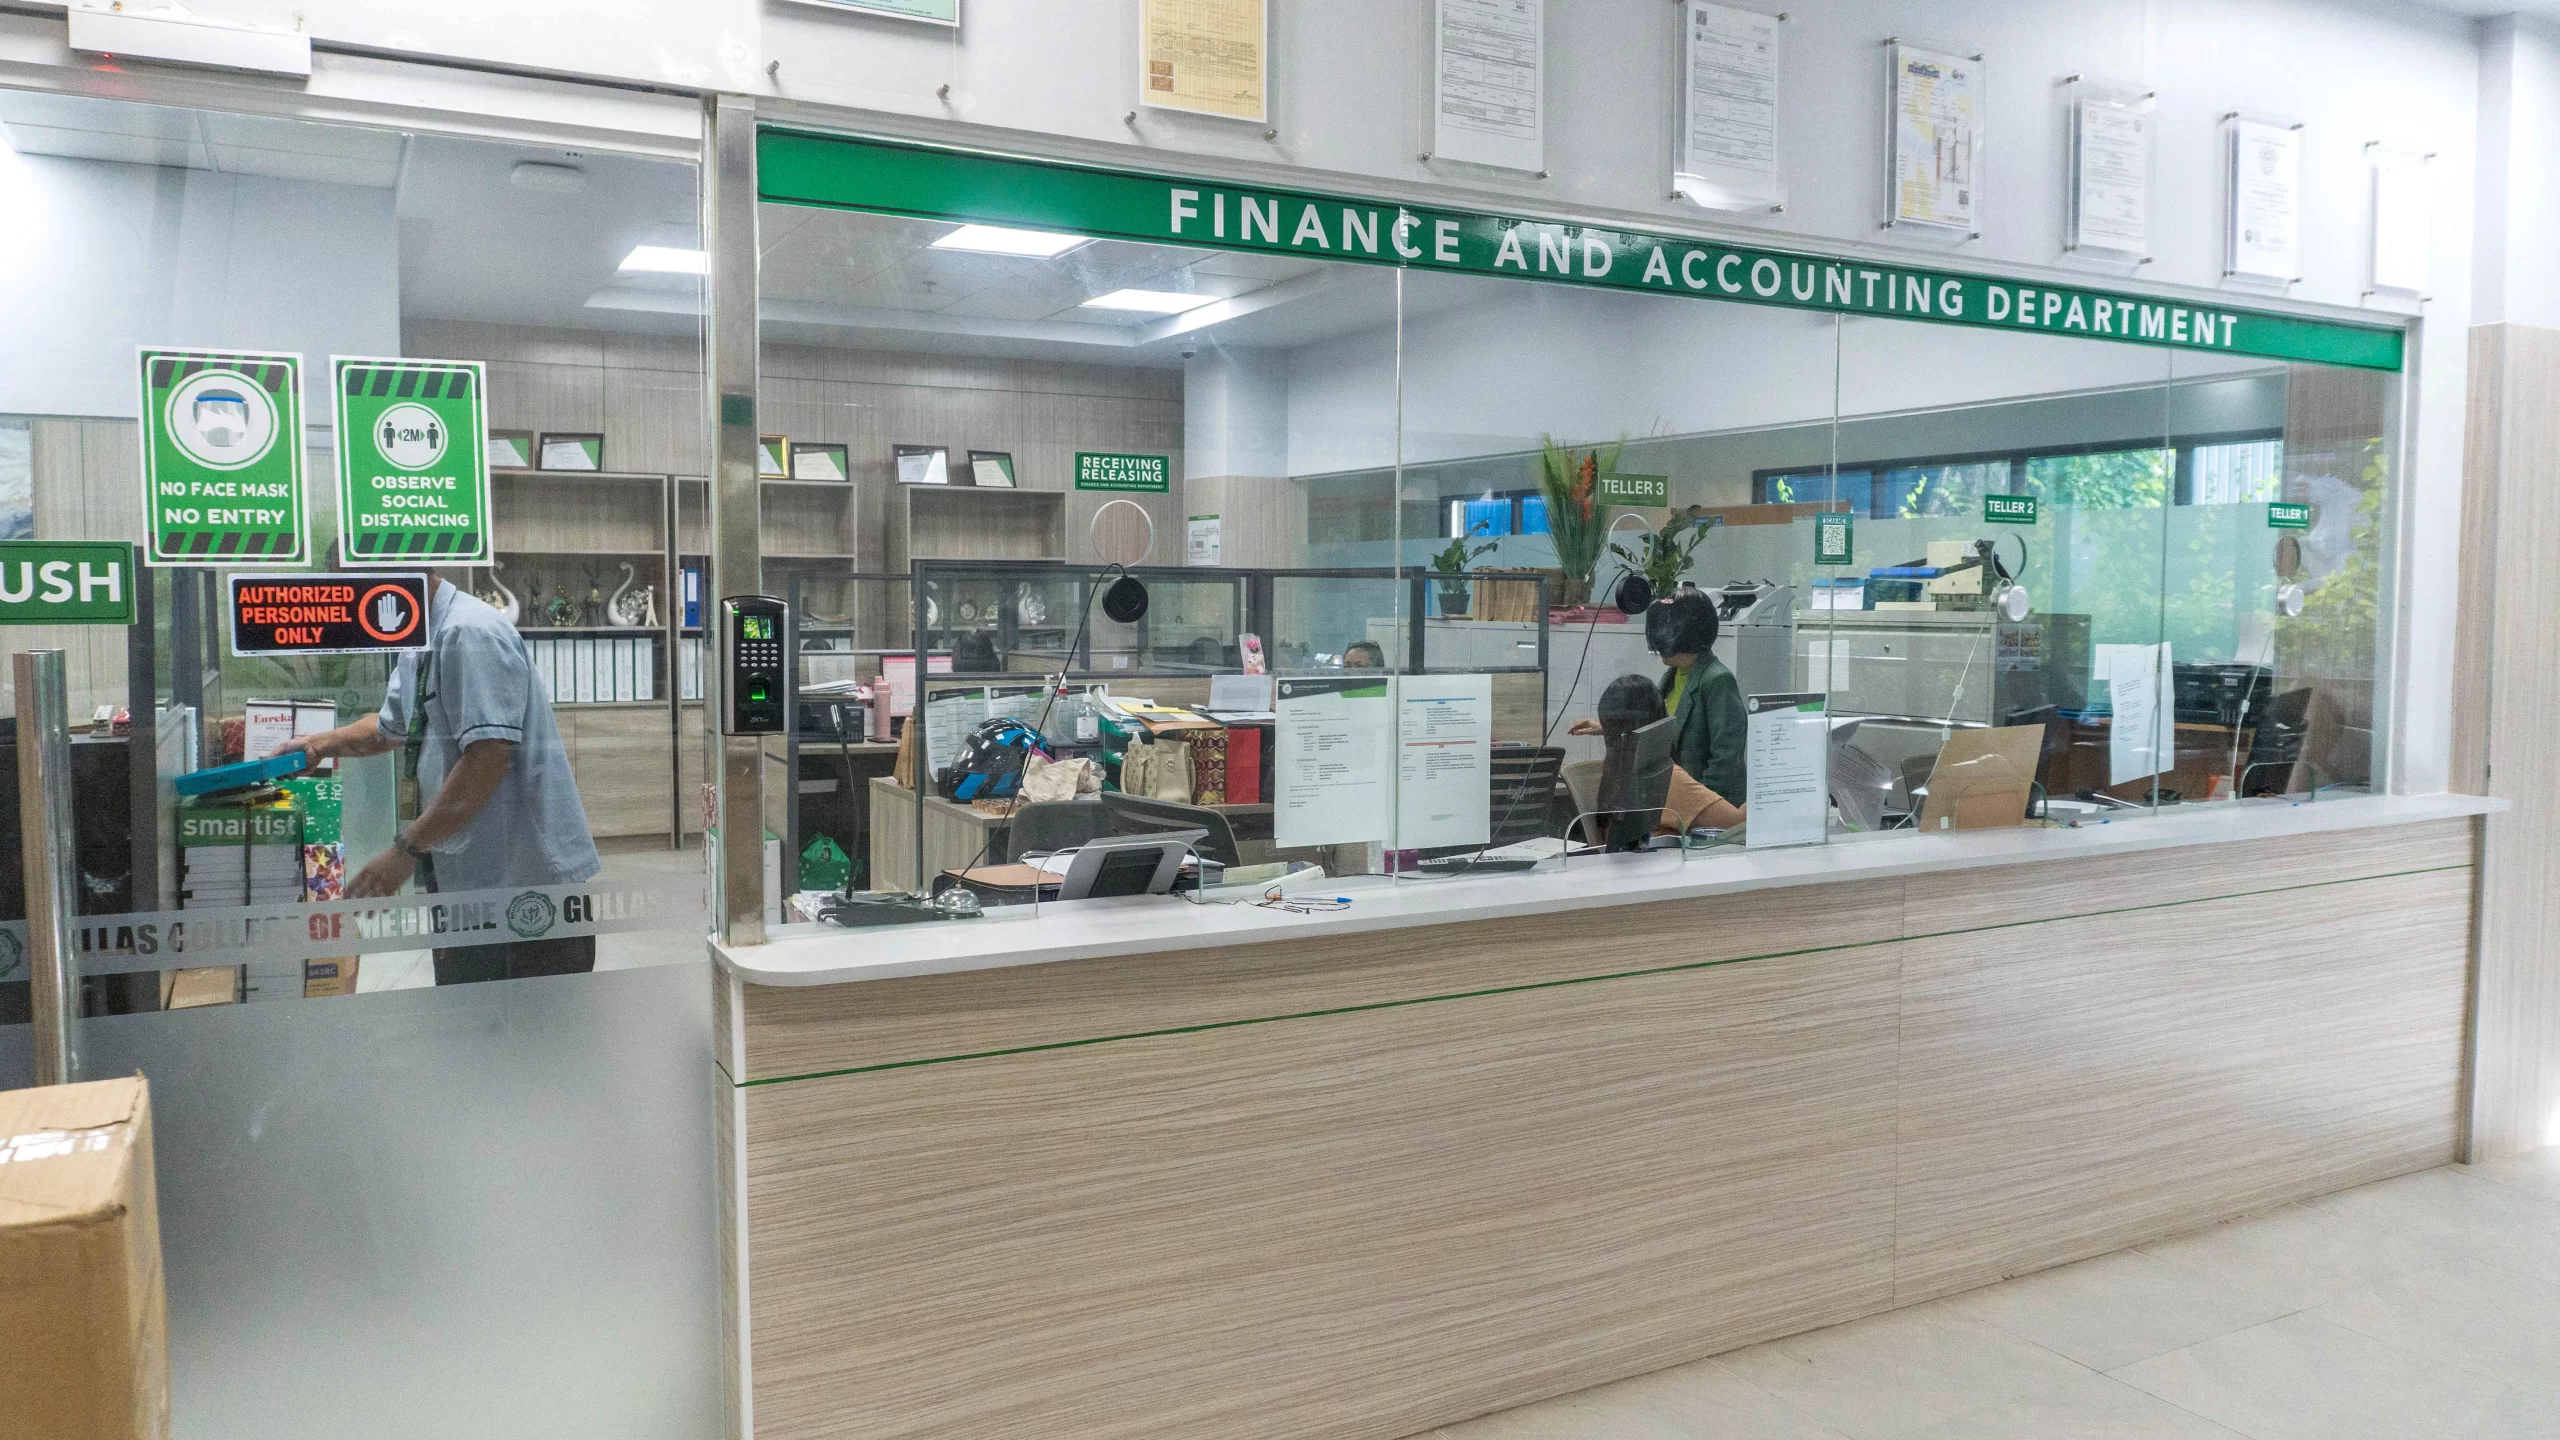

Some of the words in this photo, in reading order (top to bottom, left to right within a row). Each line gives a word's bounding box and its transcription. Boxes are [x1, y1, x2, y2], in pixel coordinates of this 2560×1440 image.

[1171, 188, 1460, 263] FINANCE
[1494, 229, 1613, 278] AND
[1642, 245, 1964, 317] ACCOUNTING
[1987, 285, 2238, 347] DEPARTMENT
[403, 428, 420, 442] 2M
[1083, 456, 1162, 471] RECEIVING
[371, 476, 456, 490] OBSERVE
[1082, 468, 1163, 482] RELEASING
[160, 481, 186, 497] NO
[191, 482, 237, 498] FACE
[242, 482, 289, 499] MASK
[1602, 479, 1653, 496] TELLER
[1656, 481, 1664, 496] 3
[381, 494, 448, 509] SOCIAL
[1988, 500, 2025, 514] TELLER
[2027, 502, 2034, 514] 2
[165, 508, 200, 525] NO
[207, 508, 286, 525] ENTRY
[361, 513, 470, 528] DISTANCING
[2270, 507, 2302, 520] TELLER
[2303, 509, 2308, 520] 1
[239, 586, 355, 605] AUTHORIZED
[241, 606, 352, 625] PERSONNEL
[274, 626, 323, 645] ONLY
[253, 712, 293, 724] Eureka
[183, 814, 297, 837] smartist
[167, 915, 300, 953] COLLE
[308, 911, 345, 943] OF
[353, 900, 497, 940] MEDICINE
